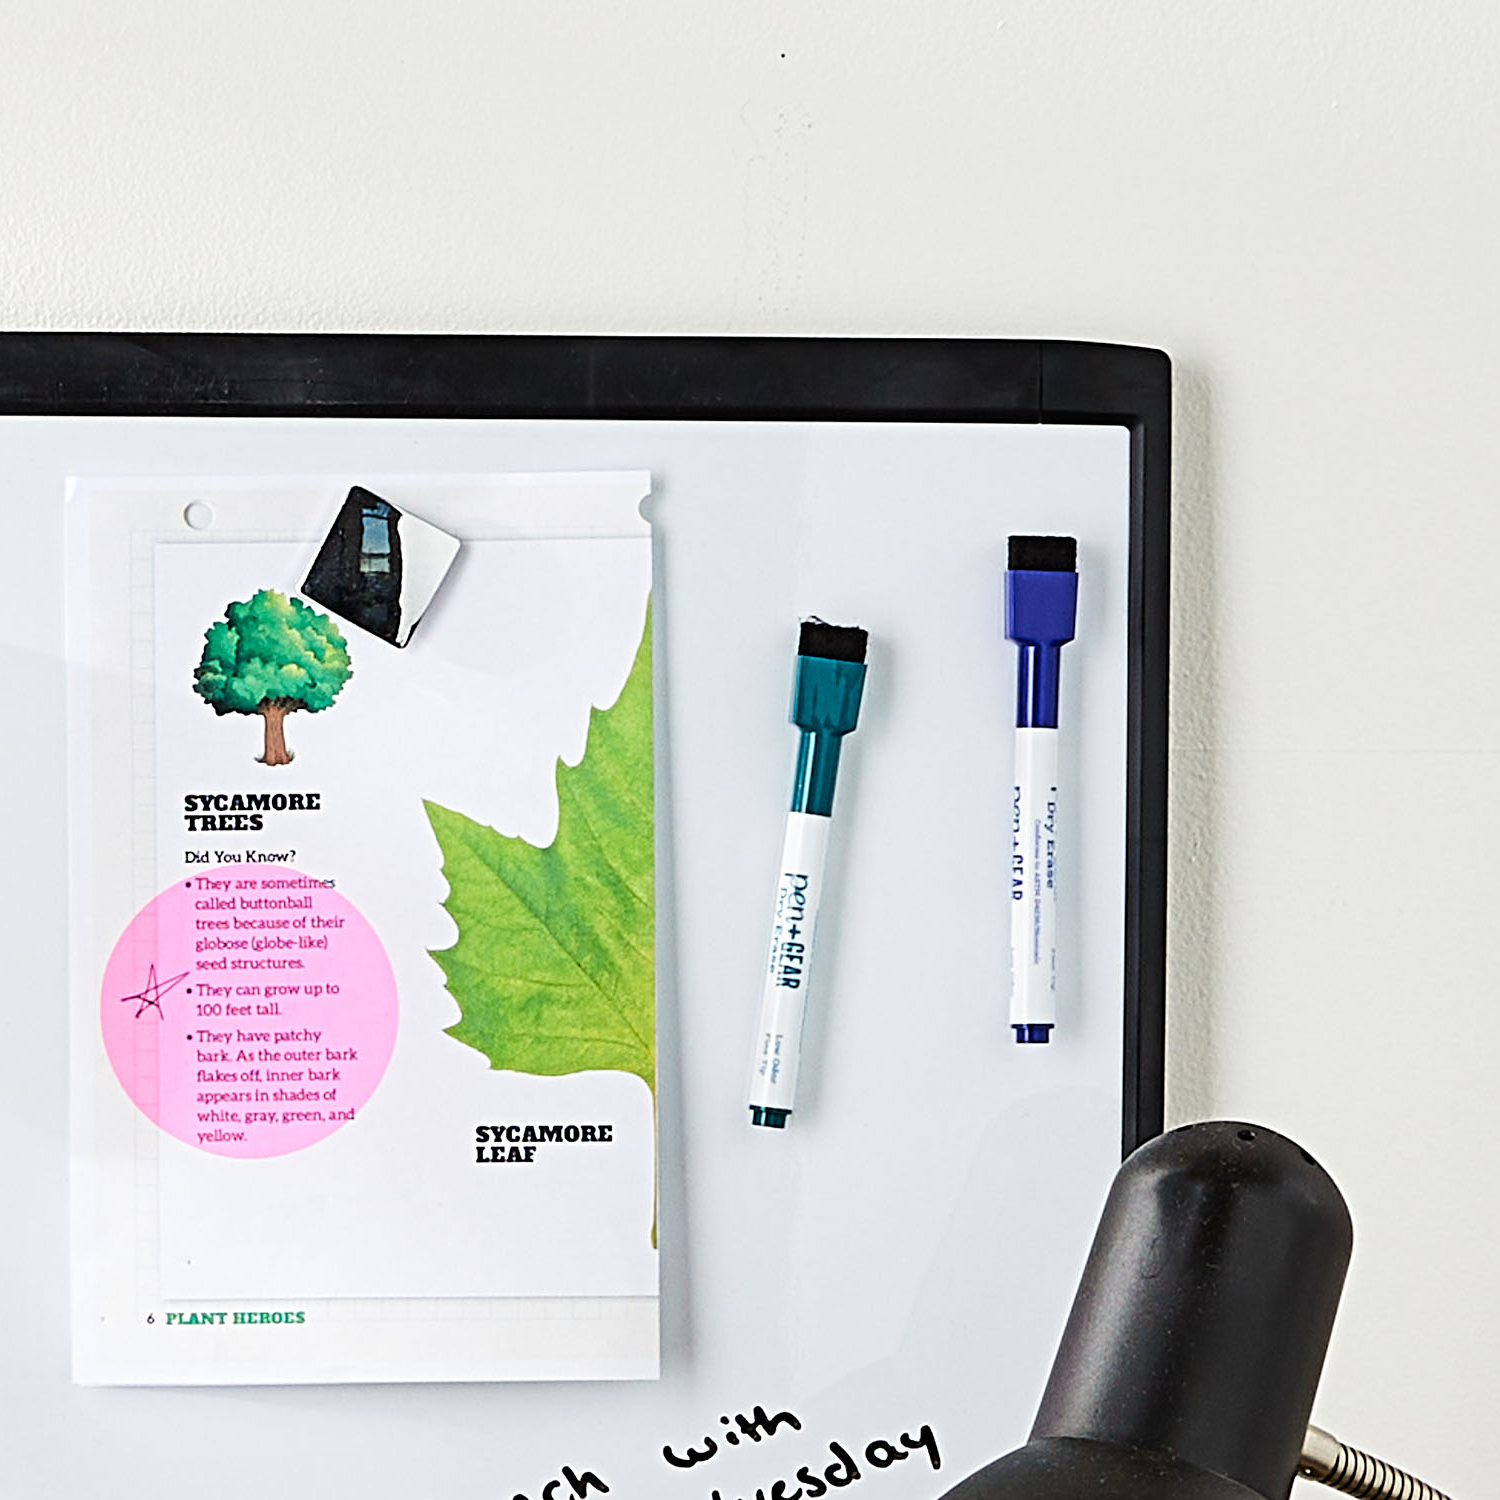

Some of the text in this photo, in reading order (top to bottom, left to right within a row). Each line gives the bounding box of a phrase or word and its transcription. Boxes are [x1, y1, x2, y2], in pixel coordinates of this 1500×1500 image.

[184, 793, 320, 812] SYCAMORE
[184, 814, 264, 832] TREES
[1044, 802, 1056, 889] Dry Erase
[185, 850, 296, 864] Did You Know?
[196, 875, 336, 892] They are sometimes
[194, 896, 313, 911] called buttonball
[196, 915, 346, 930] trees because of their
[195, 934, 328, 954] globose (globe-like)
[196, 956, 305, 971] seed structures.
[195, 983, 340, 999] They can grow up to
[196, 1002, 282, 1017] 100 feet tall.
[196, 1028, 322, 1045] They have patchy
[196, 1048, 358, 1063] bark. As the outer bark
[197, 1067, 340, 1083] flakes off, inner bark
[196, 1088, 337, 1106] appears in shades of
[197, 1107, 355, 1125] white, gray, green, and
[196, 1131, 248, 1147] yellow.
[476, 1125, 613, 1143] SYCAMORE
[476, 1146, 537, 1163] LEAF
[146, 1311, 306, 1325] 6 PLANT HEROES
[663, 1406, 802, 1468] with
